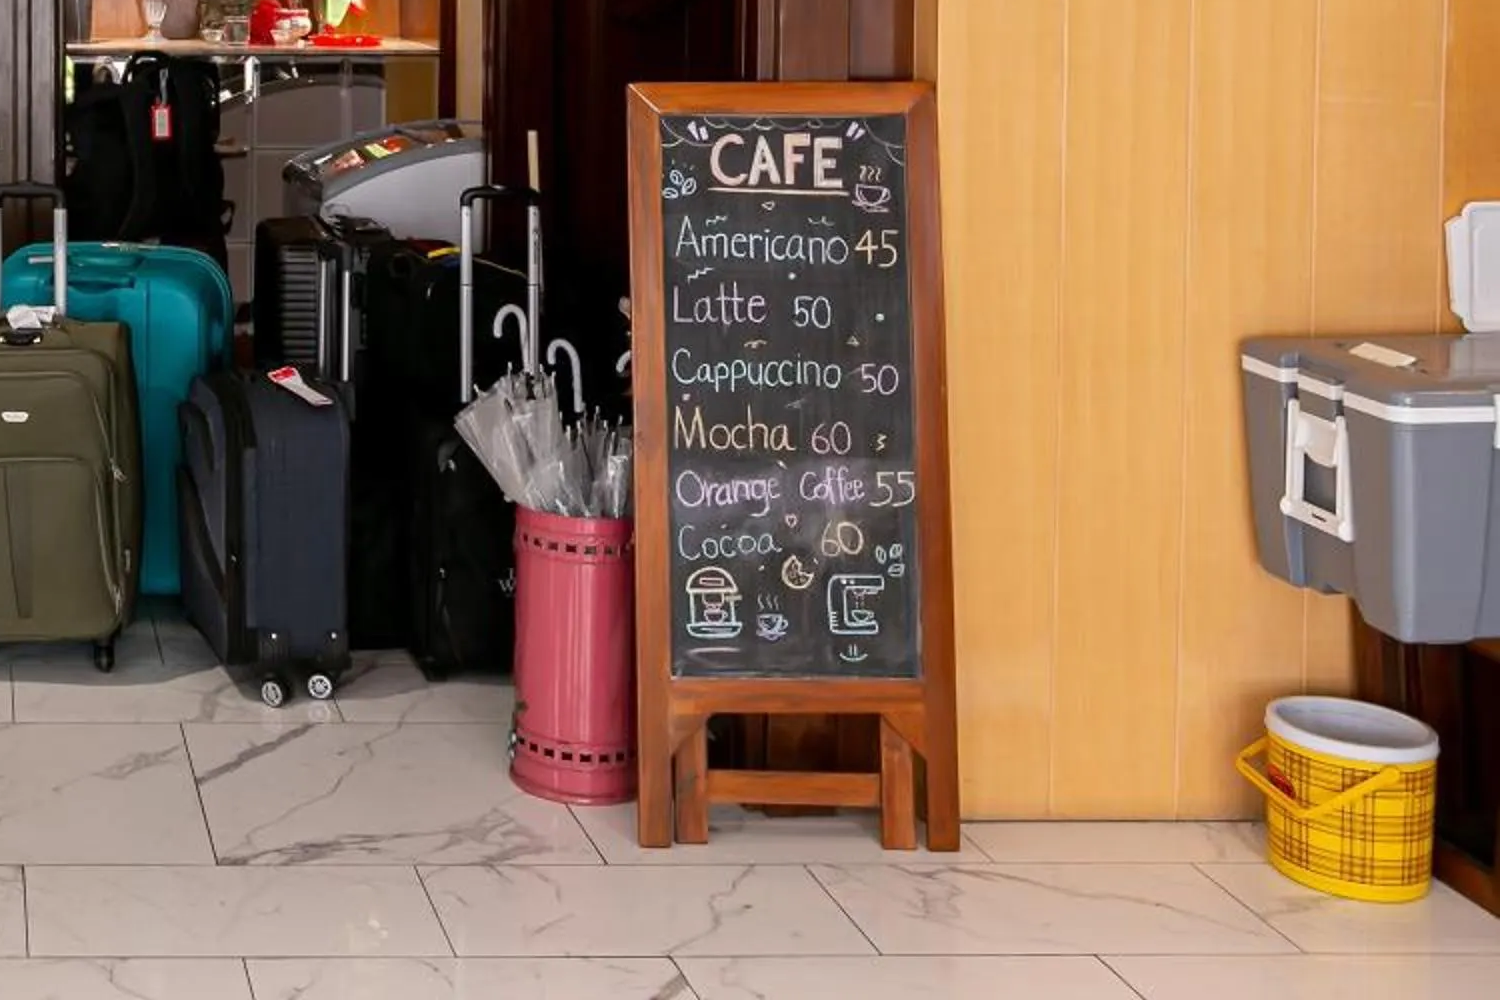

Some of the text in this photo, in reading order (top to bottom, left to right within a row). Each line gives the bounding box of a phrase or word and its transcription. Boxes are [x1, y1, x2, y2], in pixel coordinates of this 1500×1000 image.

[675, 215, 899, 268] Americano 45
[672, 281, 831, 329] Latte 50
[671, 348, 899, 396] Cappuccino 50
[674, 405, 851, 455] Mocha 60
[676, 466, 916, 517] Orange Coffee 55
[678, 521, 864, 561] Cocoa 60
